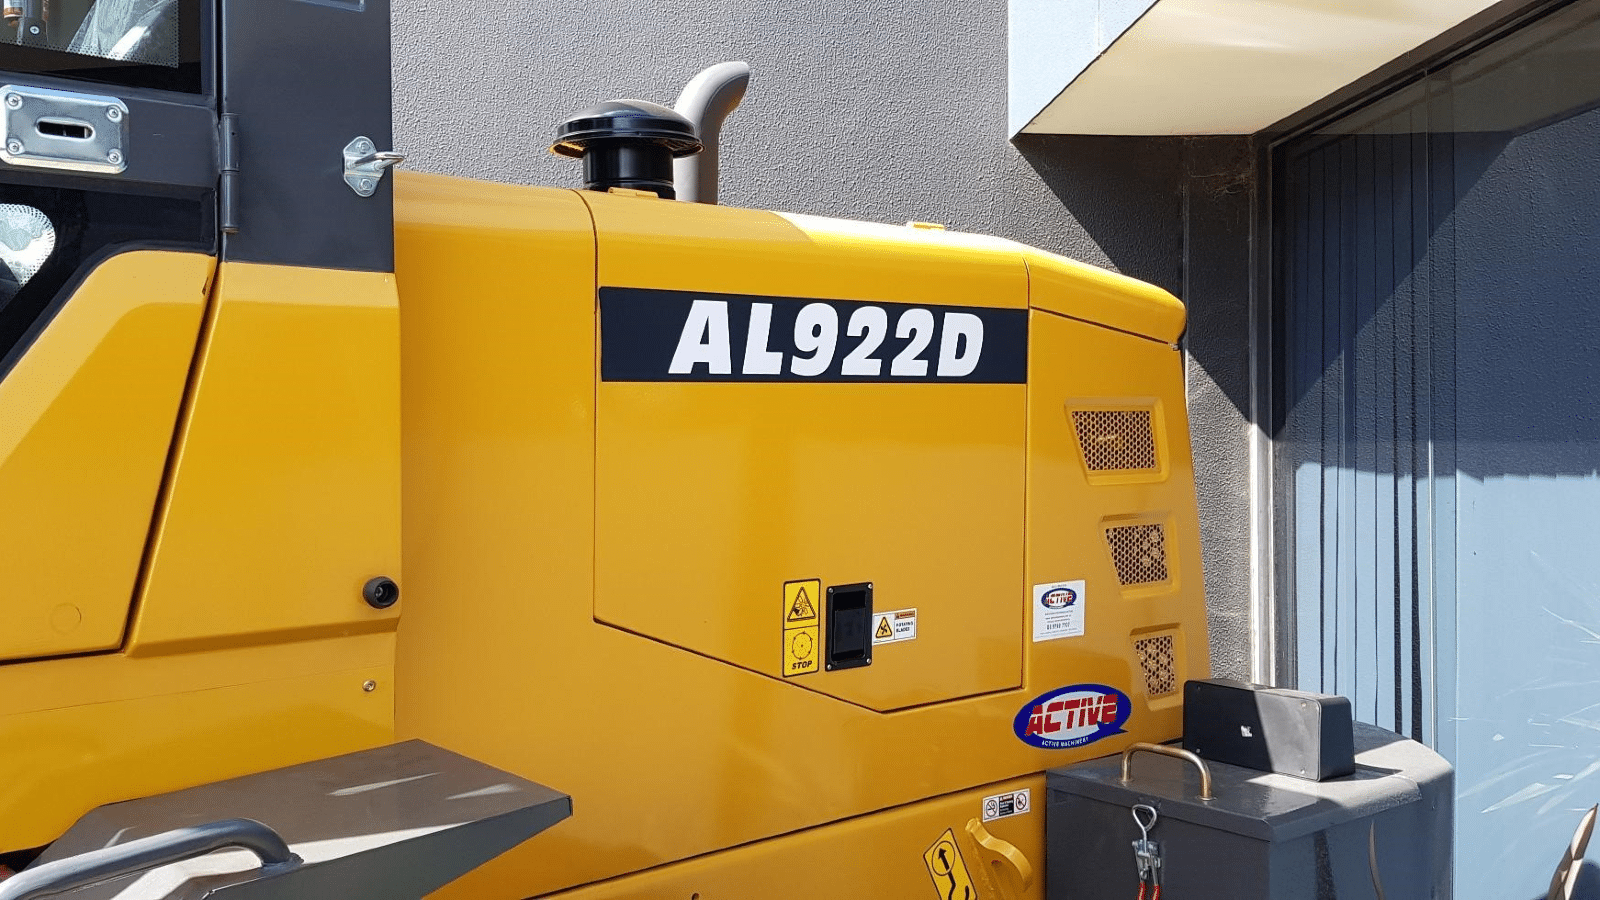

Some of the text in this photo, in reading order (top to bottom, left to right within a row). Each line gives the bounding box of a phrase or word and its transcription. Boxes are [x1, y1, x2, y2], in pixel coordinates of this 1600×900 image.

[668, 299, 984, 377] AL922D
[791, 660, 813, 670] STOP
[1025, 694, 1118, 737] ACTIVE
[1041, 737, 1090, 748] ACTIVE MACHINERY
